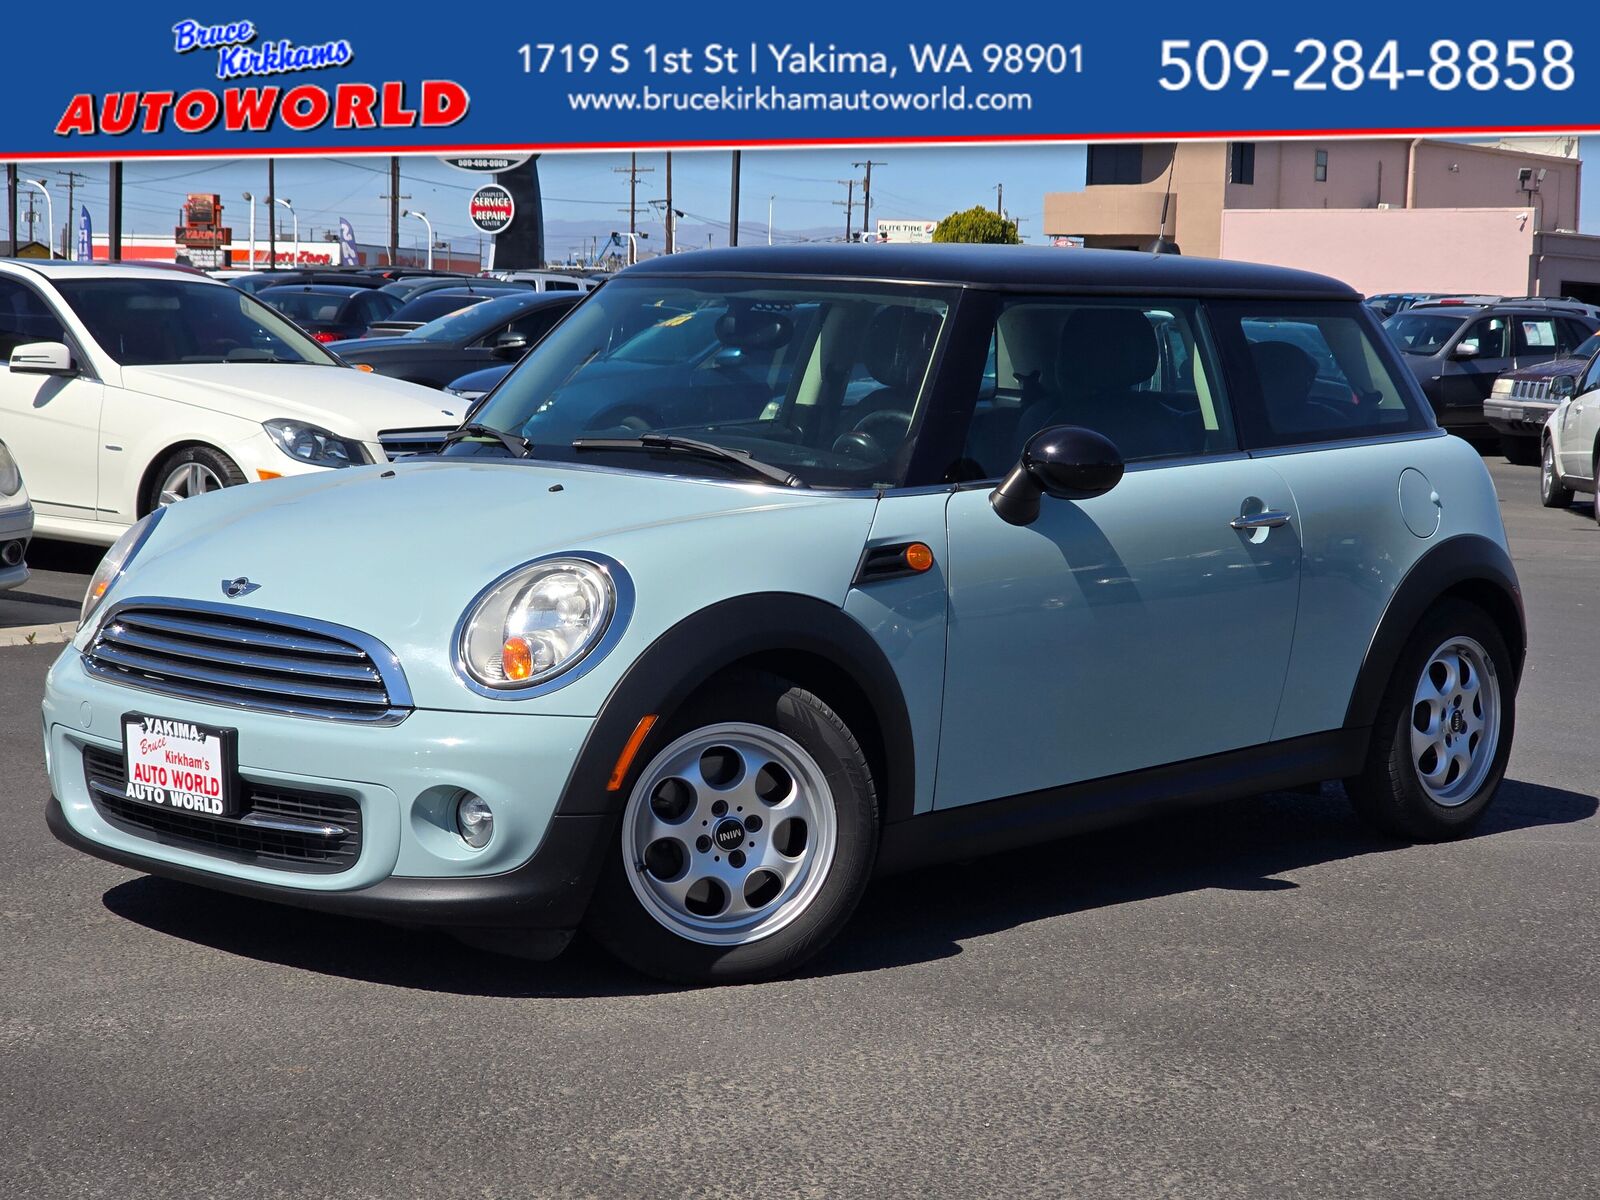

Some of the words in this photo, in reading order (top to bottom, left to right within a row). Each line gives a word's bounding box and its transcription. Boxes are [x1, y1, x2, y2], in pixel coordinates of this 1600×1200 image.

[474, 197, 508, 207] SERVICE
[475, 211, 506, 221] REPAIR
[144, 718, 200, 740] YAKIMA
[140, 737, 167, 755] Bruce
[165, 750, 209, 770] Kirkham's
[134, 763, 167, 786] AUTO
[171, 770, 219, 796] WORLD
[126, 783, 165, 803] AUTO
[170, 791, 223, 814] WORLD
[720, 829, 741, 841] MINI
